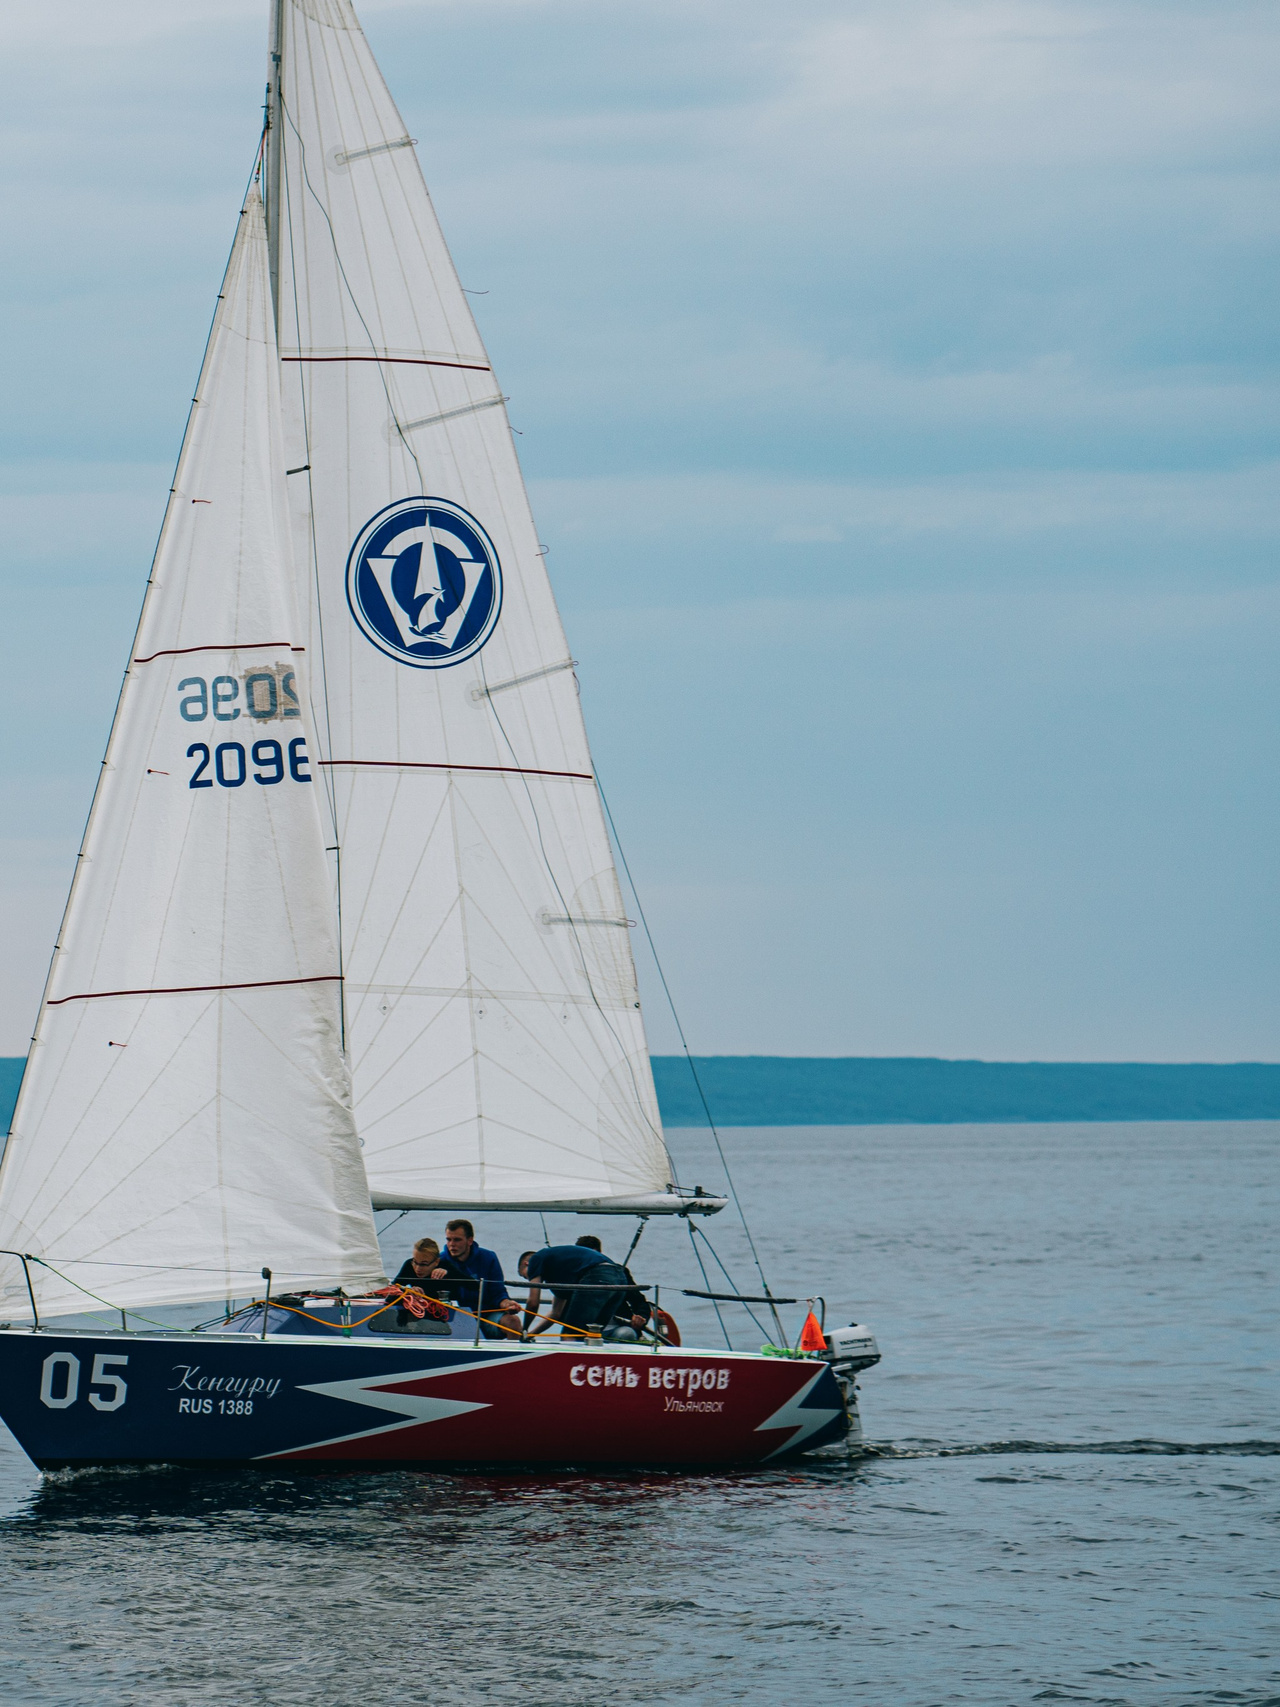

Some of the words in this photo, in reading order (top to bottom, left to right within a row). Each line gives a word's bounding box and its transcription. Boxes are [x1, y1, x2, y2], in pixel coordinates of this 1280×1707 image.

[40, 1352, 129, 1412] 05
[167, 1365, 282, 1399] Кенгуру
[179, 1398, 213, 1414] RUS
[218, 1400, 253, 1415] 1388
[663, 1396, 725, 1413] Ульяновск
